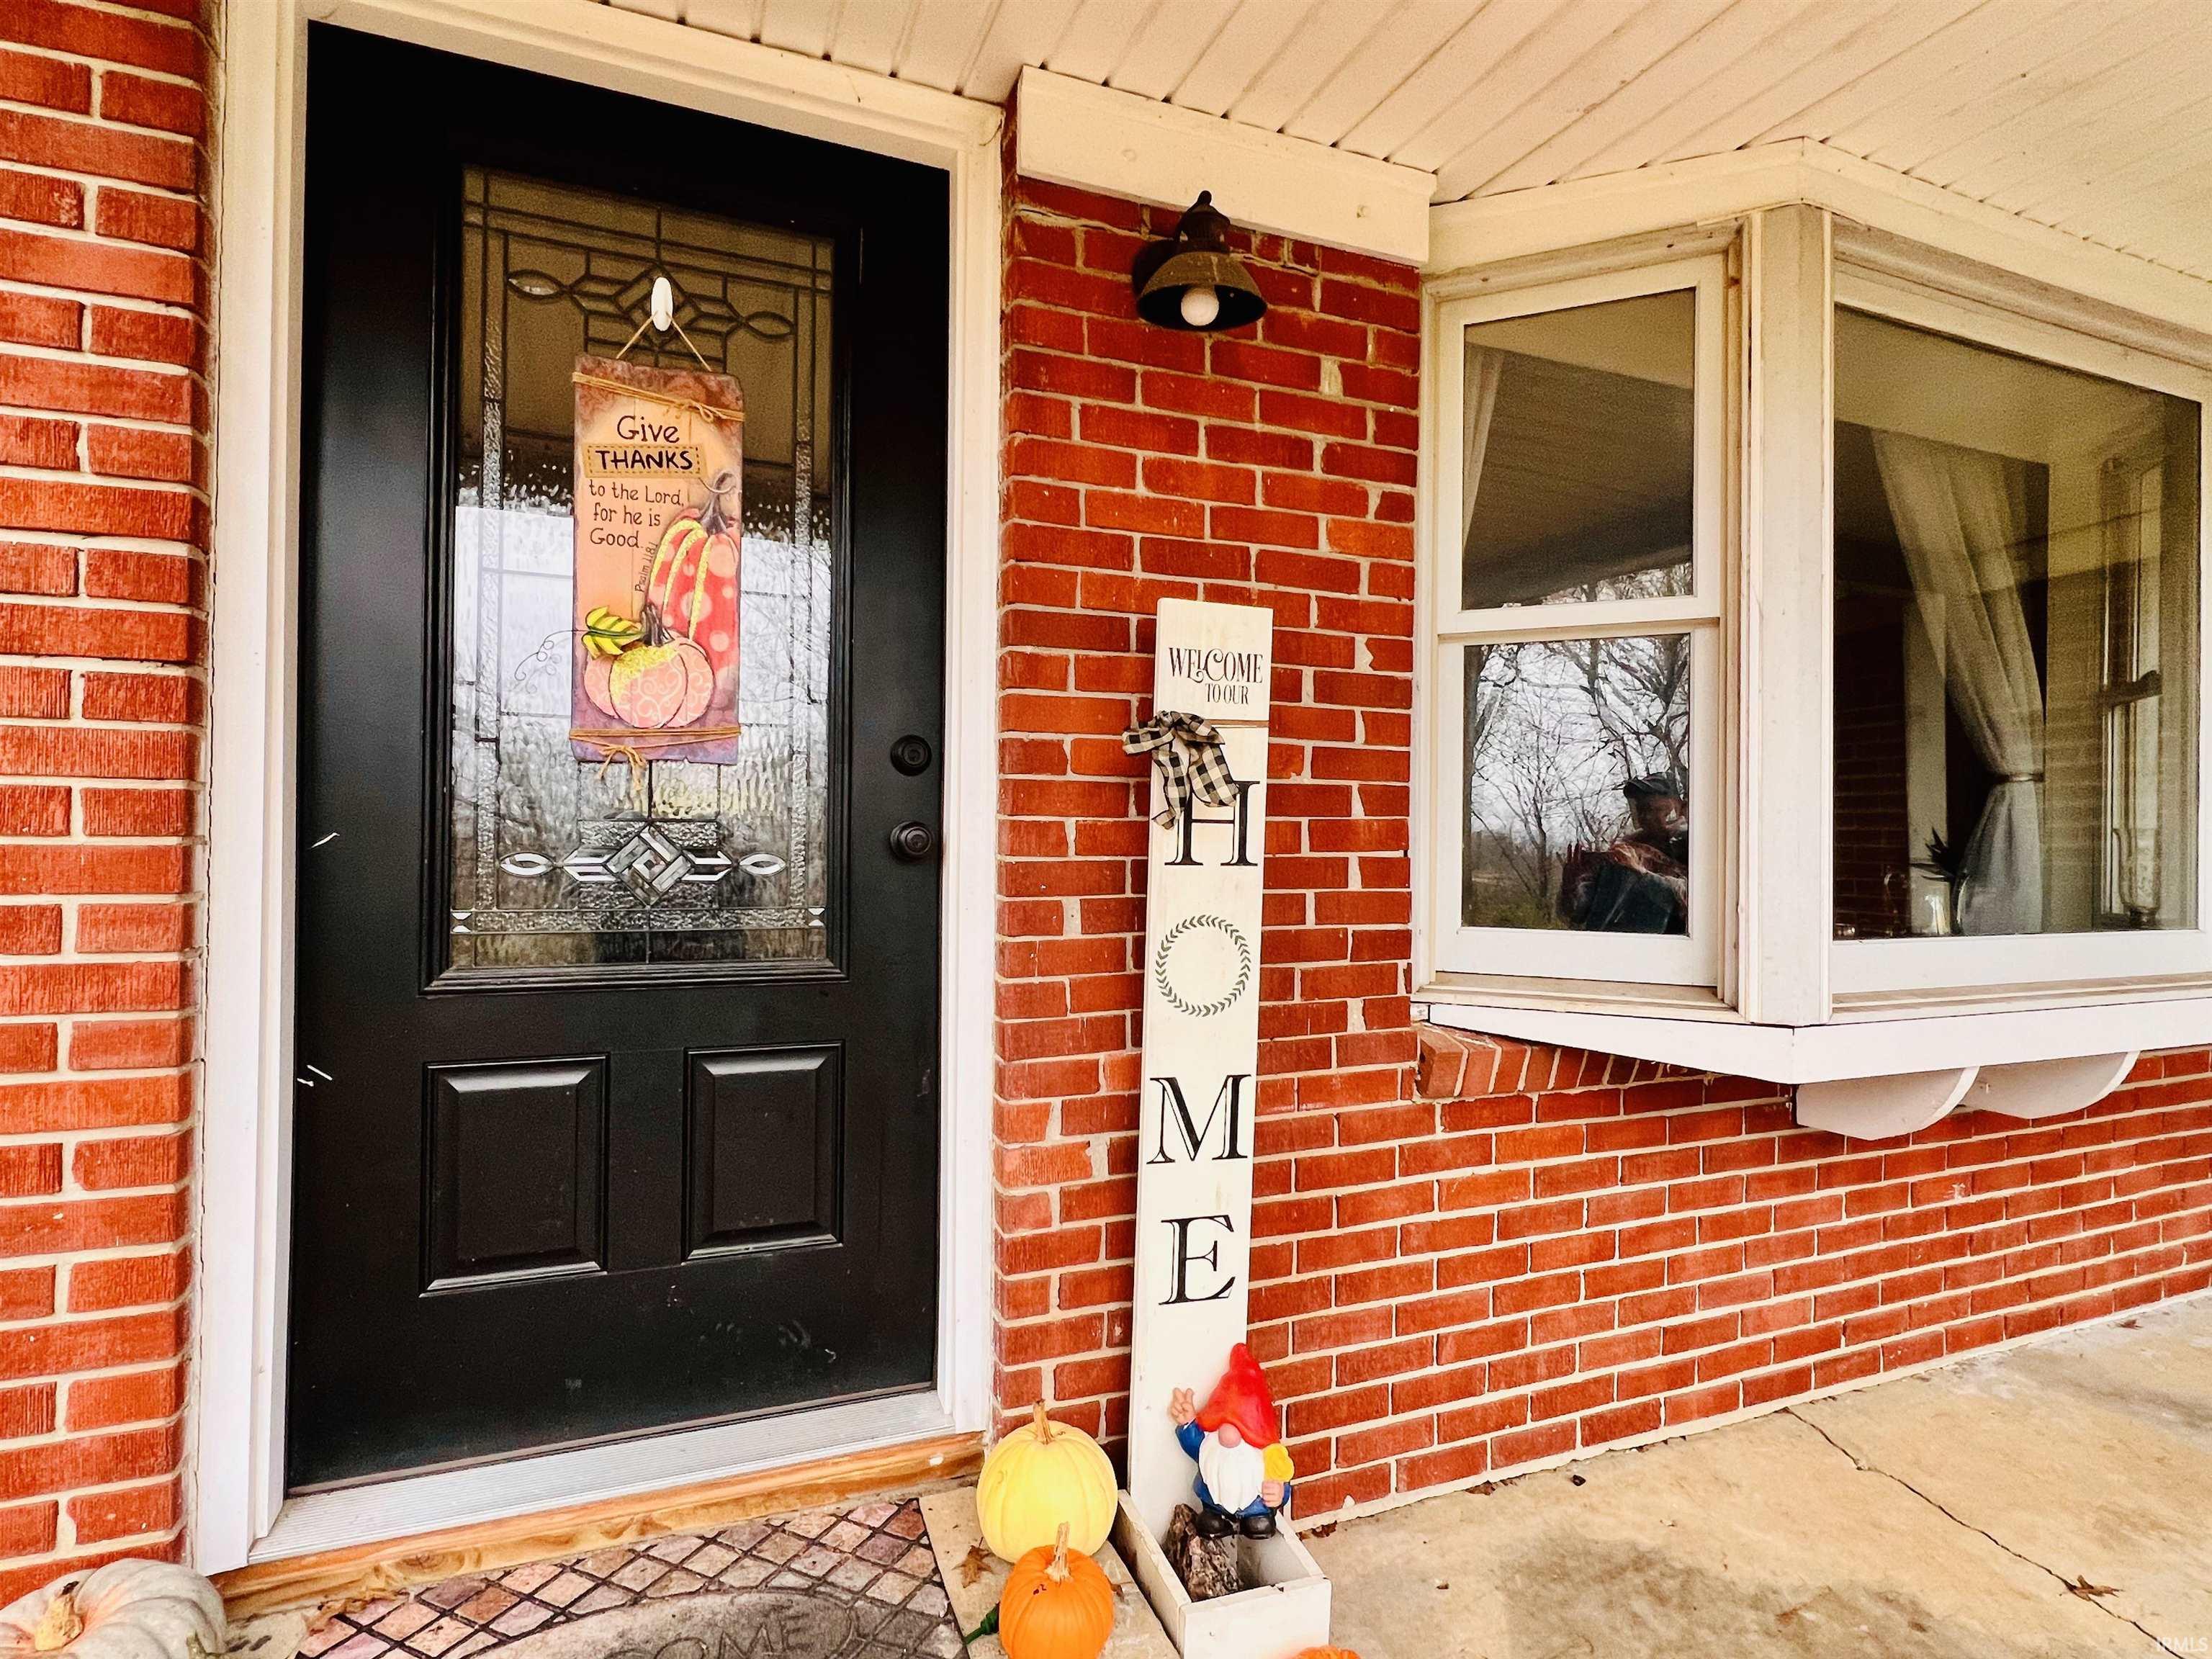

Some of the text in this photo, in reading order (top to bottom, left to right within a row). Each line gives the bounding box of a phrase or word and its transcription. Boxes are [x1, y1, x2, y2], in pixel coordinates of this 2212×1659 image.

[618, 415, 680, 444] Give
[595, 449, 693, 470] THANKS
[589, 479, 606, 497] to
[611, 481, 639, 500] the
[593, 502, 660, 526] for he is
[1169, 647, 1263, 684] WELCOME
[1205, 683, 1249, 705] TO OUR
